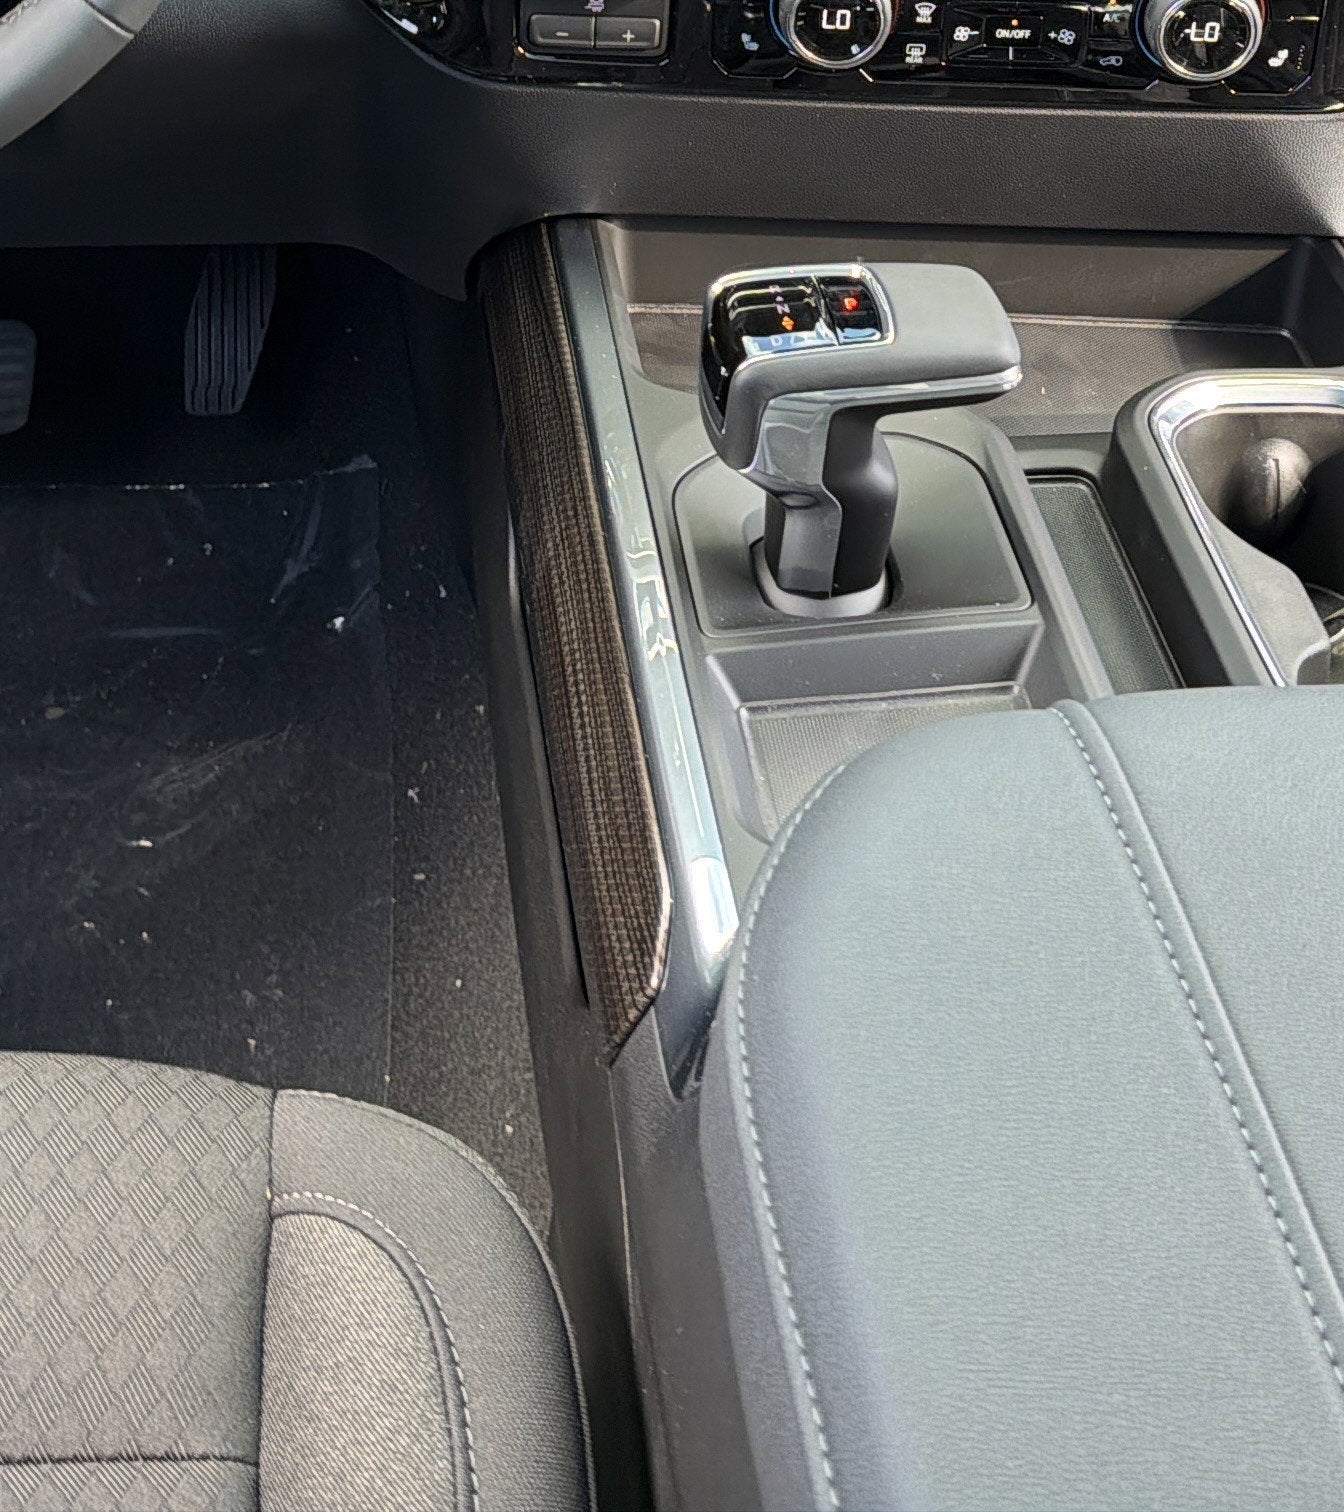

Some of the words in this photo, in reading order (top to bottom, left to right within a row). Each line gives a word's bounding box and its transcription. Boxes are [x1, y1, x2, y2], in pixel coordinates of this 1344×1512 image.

[822, 9, 851, 30] LO
[1103, 11, 1121, 24] A/C
[995, 28, 1031, 40] ON/OFF
[1189, 21, 1220, 43] LO
